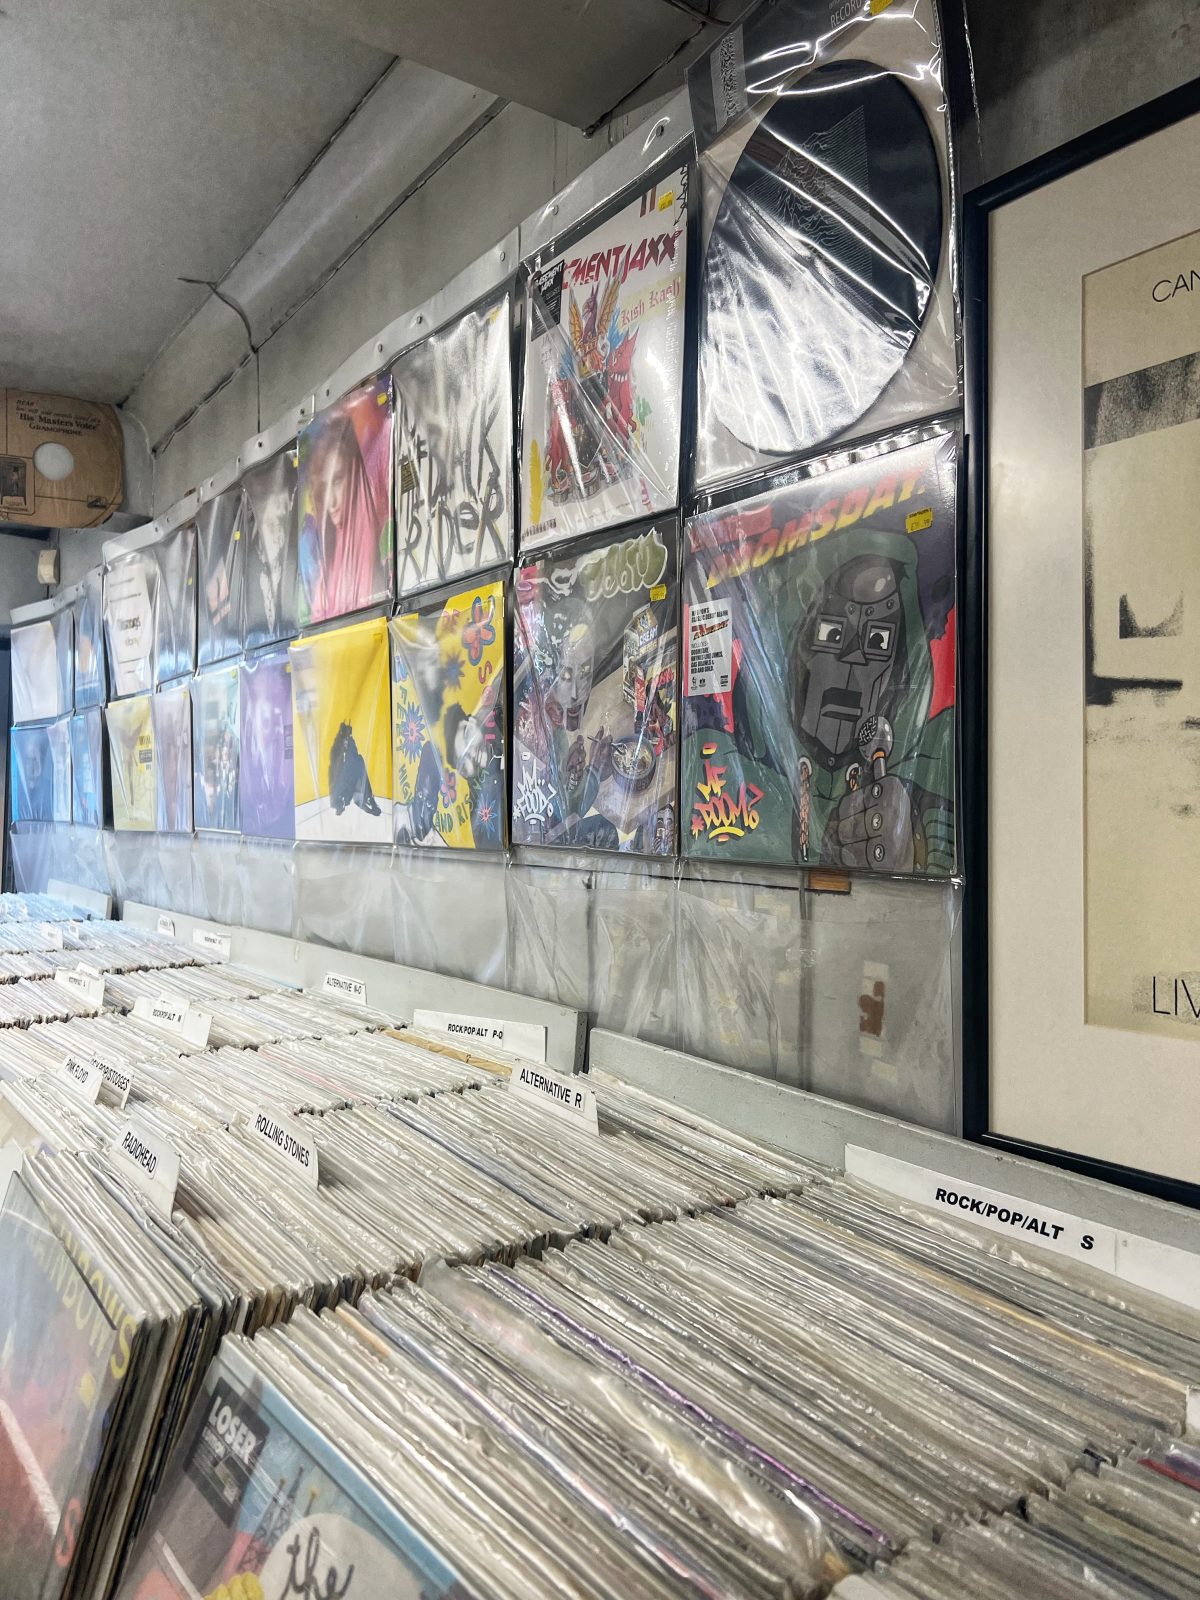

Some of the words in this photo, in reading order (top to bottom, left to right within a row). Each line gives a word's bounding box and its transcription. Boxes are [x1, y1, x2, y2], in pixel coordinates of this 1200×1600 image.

[326, 976, 353, 992] ALTERNATIVE
[447, 1023, 488, 1038] ROCK/POP/ALT
[492, 1029, 504, 1040] P-Q
[519, 1068, 571, 1104] ALTERNATIVE
[574, 1092, 582, 1109] R
[122, 1131, 158, 1174] RADIOHEAD
[255, 1113, 285, 1147] ROLLING
[283, 1134, 310, 1168] STONES
[935, 1187, 1065, 1240] ROCK/POP/ALT
[1080, 1234, 1095, 1251] S
[208, 1396, 257, 1465] LOSER
